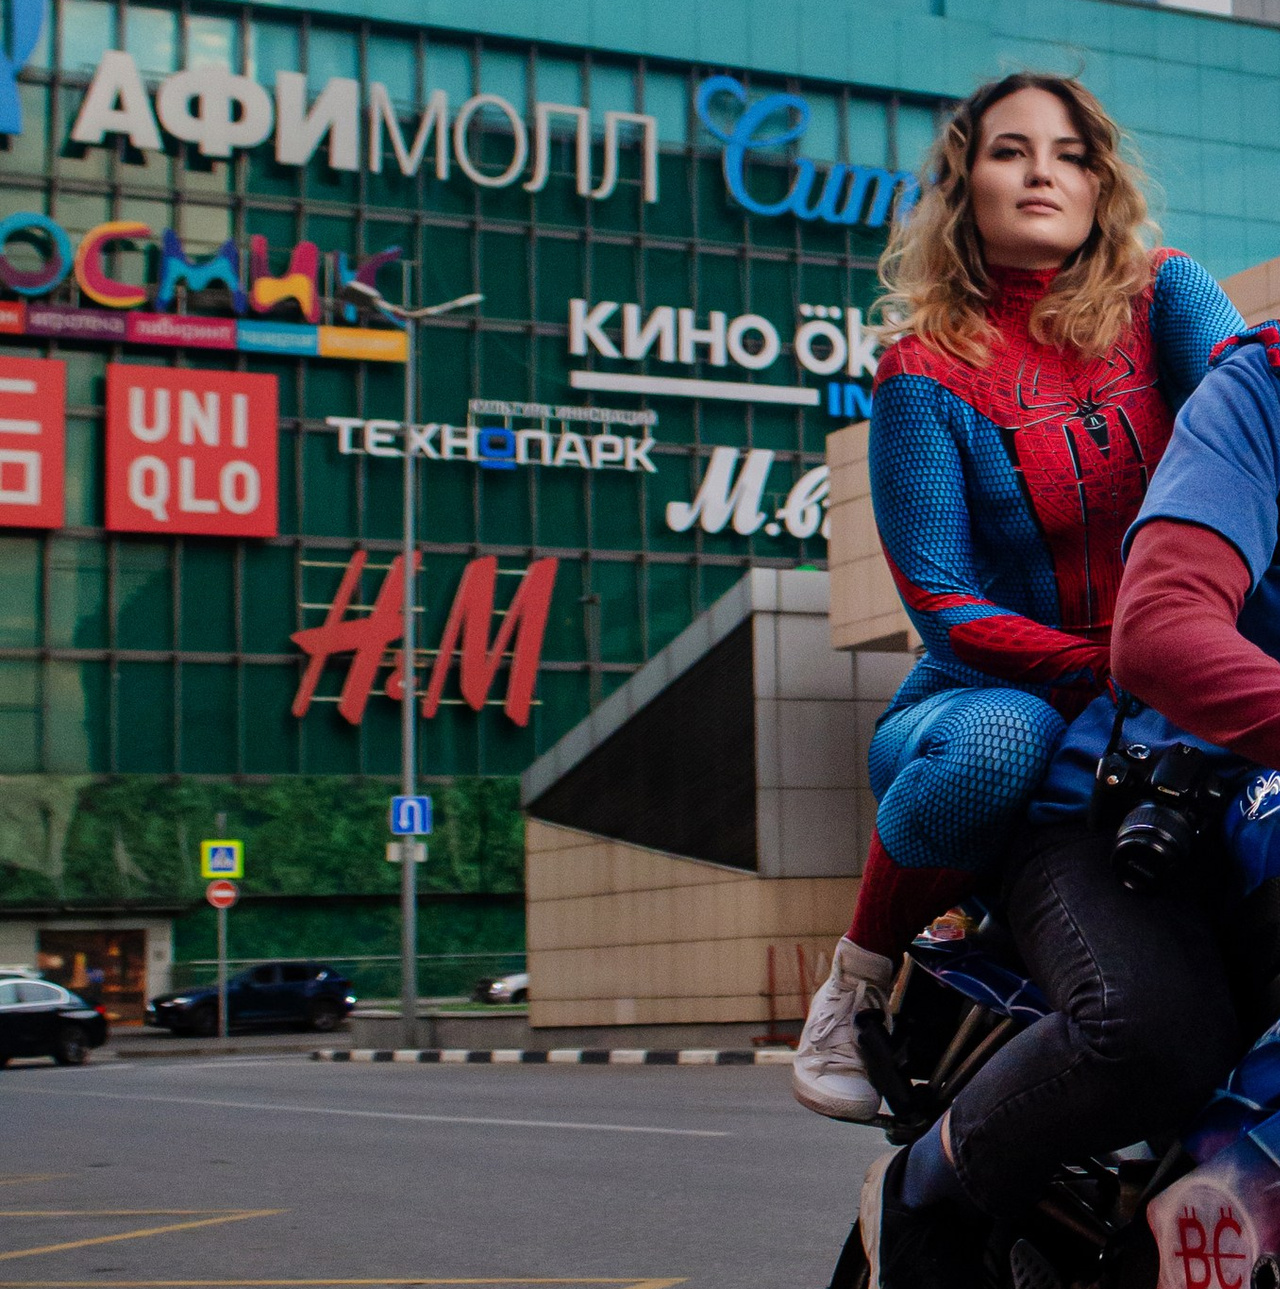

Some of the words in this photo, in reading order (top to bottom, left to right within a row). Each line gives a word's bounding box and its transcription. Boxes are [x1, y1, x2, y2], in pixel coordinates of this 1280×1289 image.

[72, 49, 660, 204] АФИМОЛЛ
[694, 76, 920, 229] Сит
[568, 298, 781, 370] КИНО
[129, 386, 248, 449] UNI
[325, 416, 658, 472] ТЕХНОПАРК
[129, 455, 261, 522] QLO
